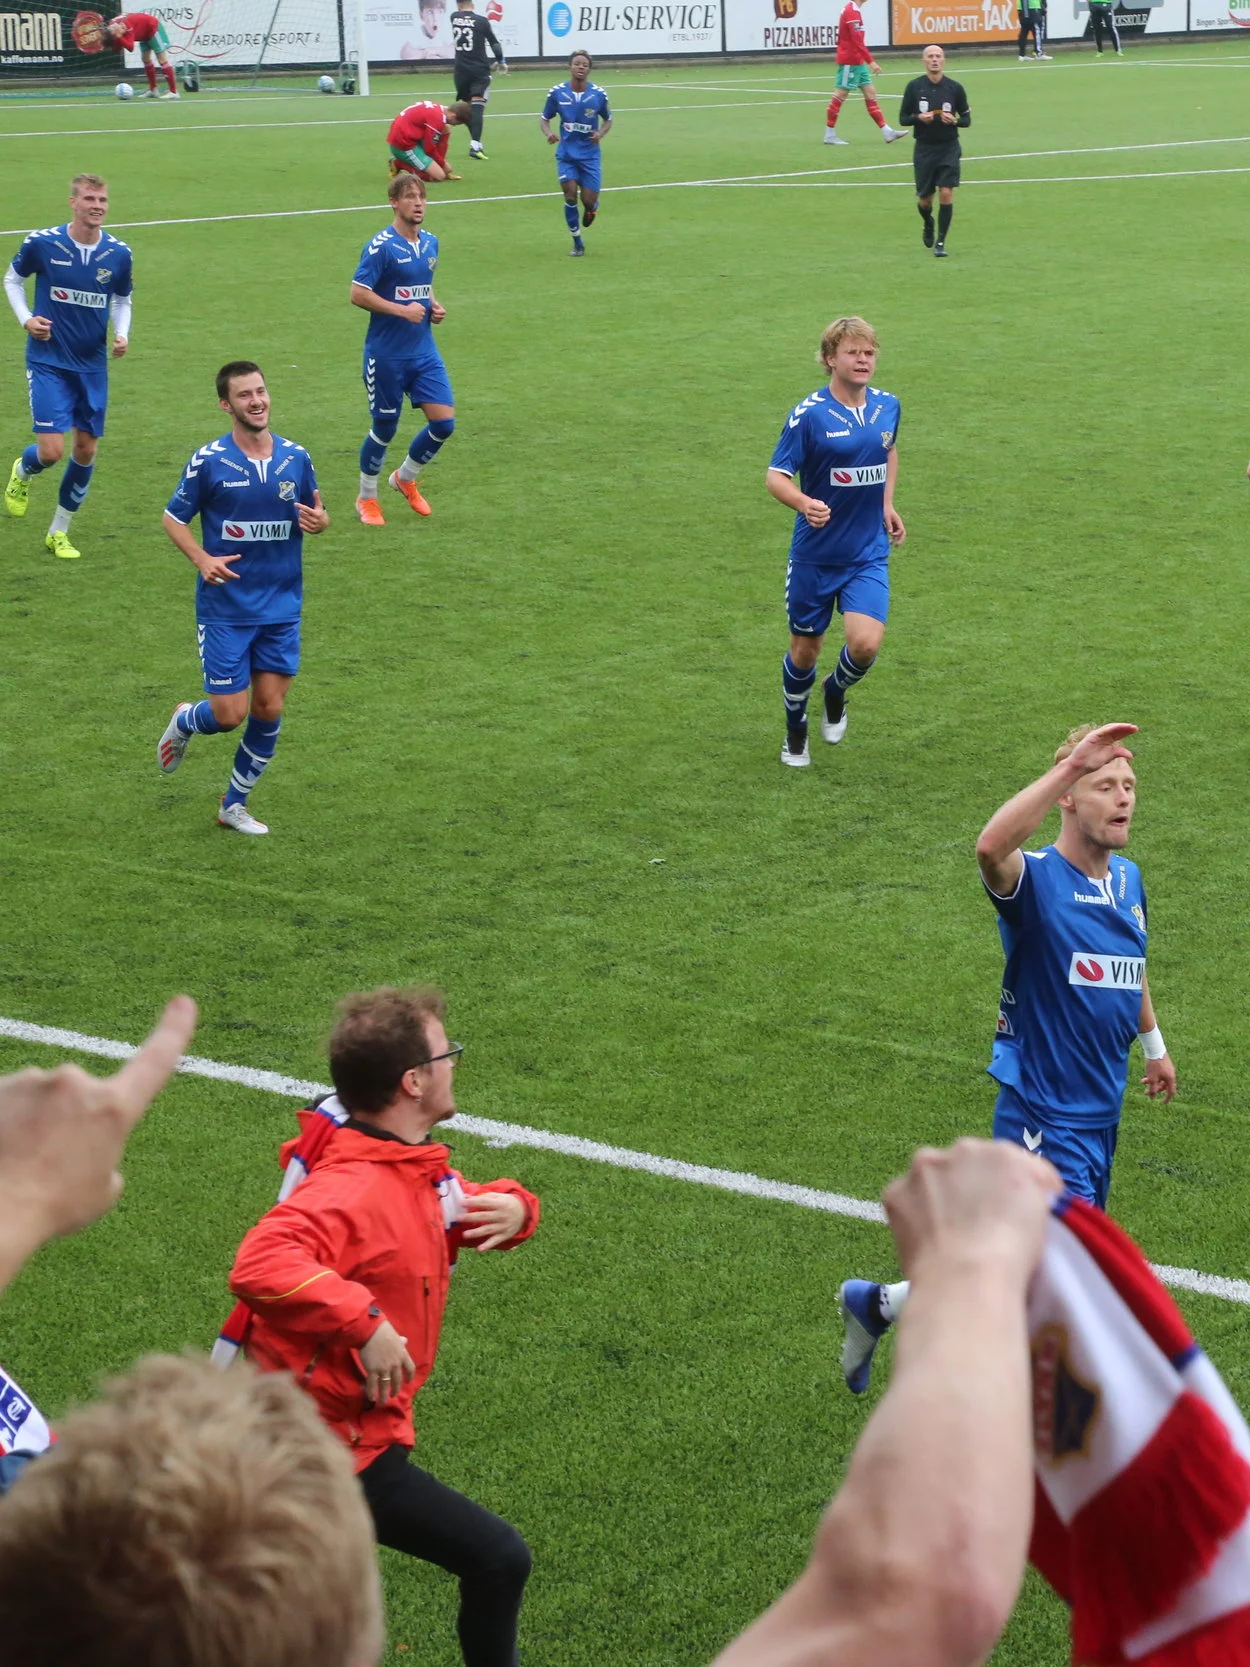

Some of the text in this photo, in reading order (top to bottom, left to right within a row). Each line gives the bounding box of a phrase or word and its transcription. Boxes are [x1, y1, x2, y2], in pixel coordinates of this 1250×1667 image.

[453, 27, 474, 52] 23
[763, 26, 839, 48] PIZZABAKERE
[223, 479, 250, 488] hummel
[250, 524, 287, 539] VISMA
